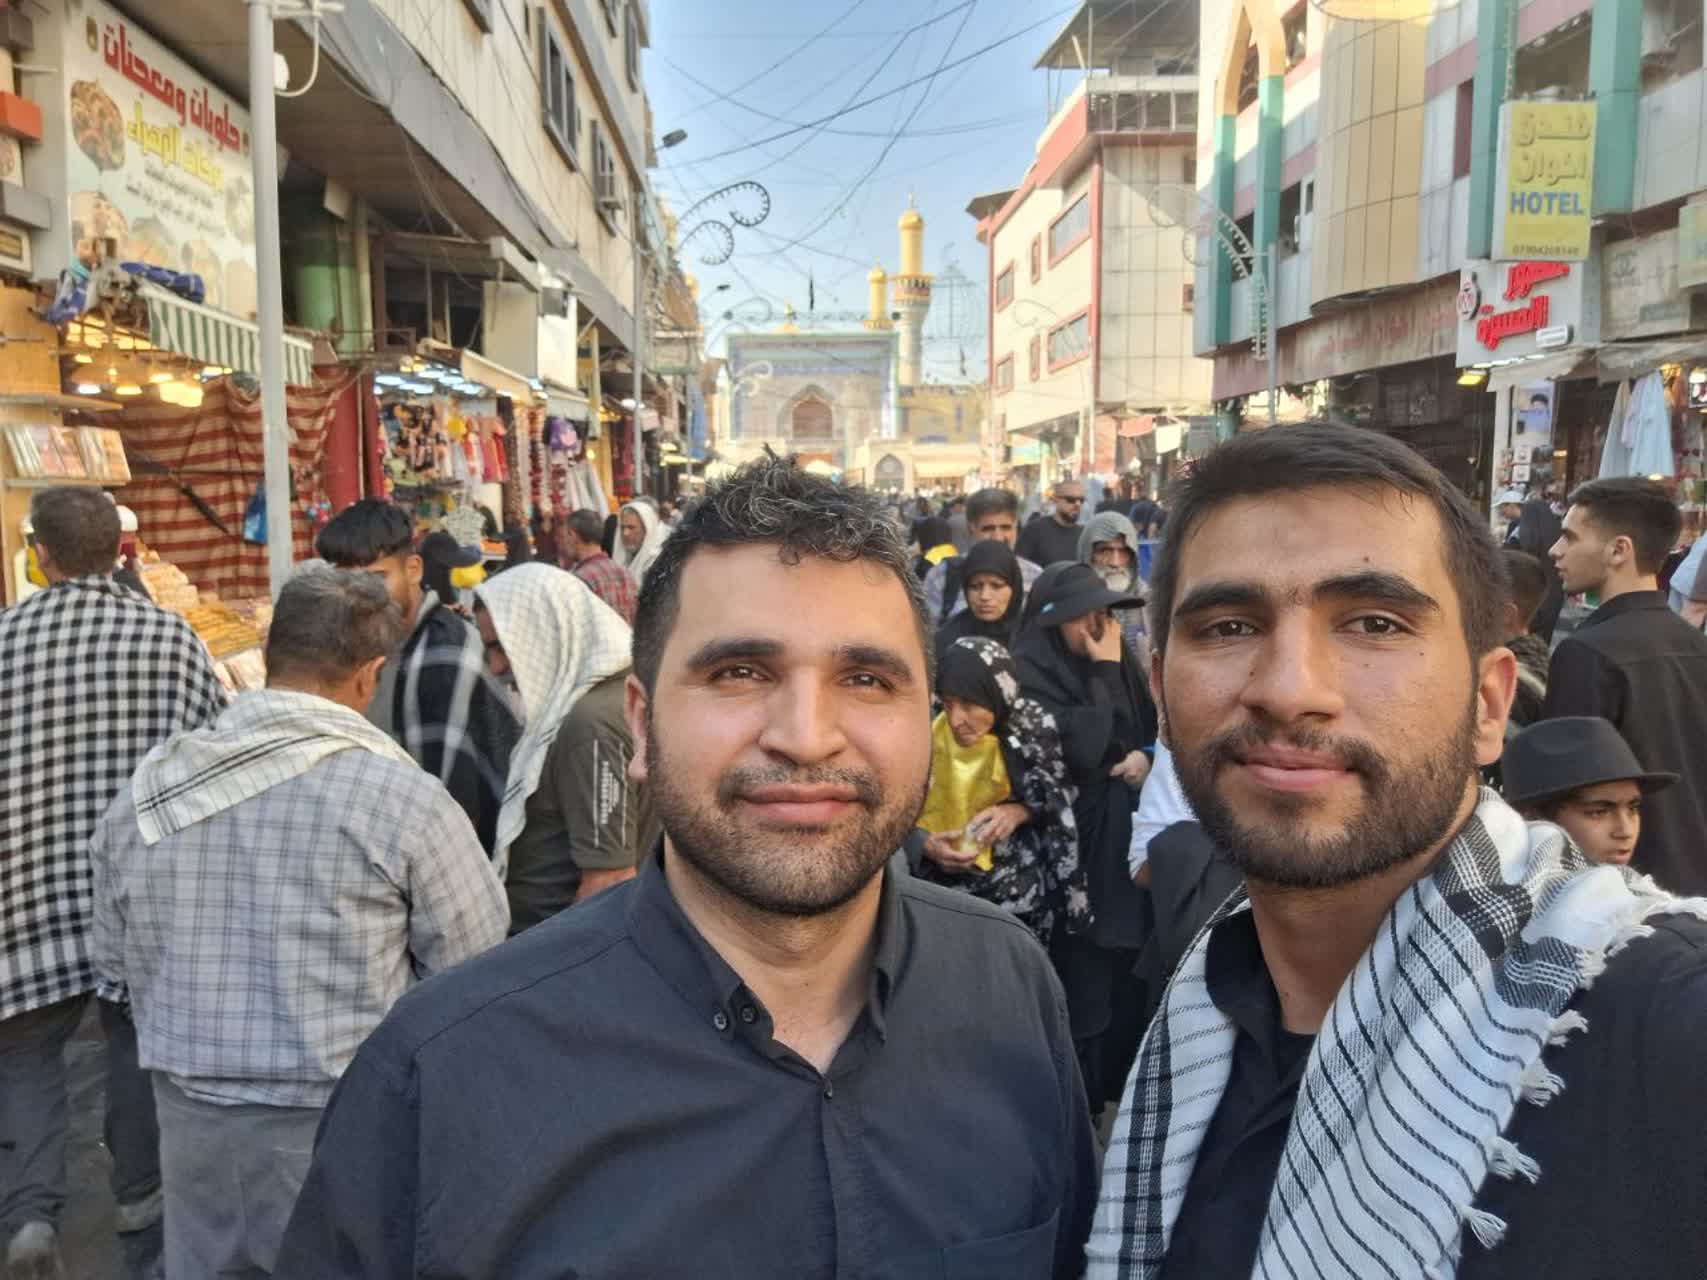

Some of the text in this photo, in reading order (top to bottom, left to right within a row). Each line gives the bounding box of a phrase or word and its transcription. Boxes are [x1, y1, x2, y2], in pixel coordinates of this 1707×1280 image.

[103, 23, 241, 153] حلويات ومعجنات
[1516, 111, 1592, 146] فندق
[1510, 192, 1585, 215] HOTEL
